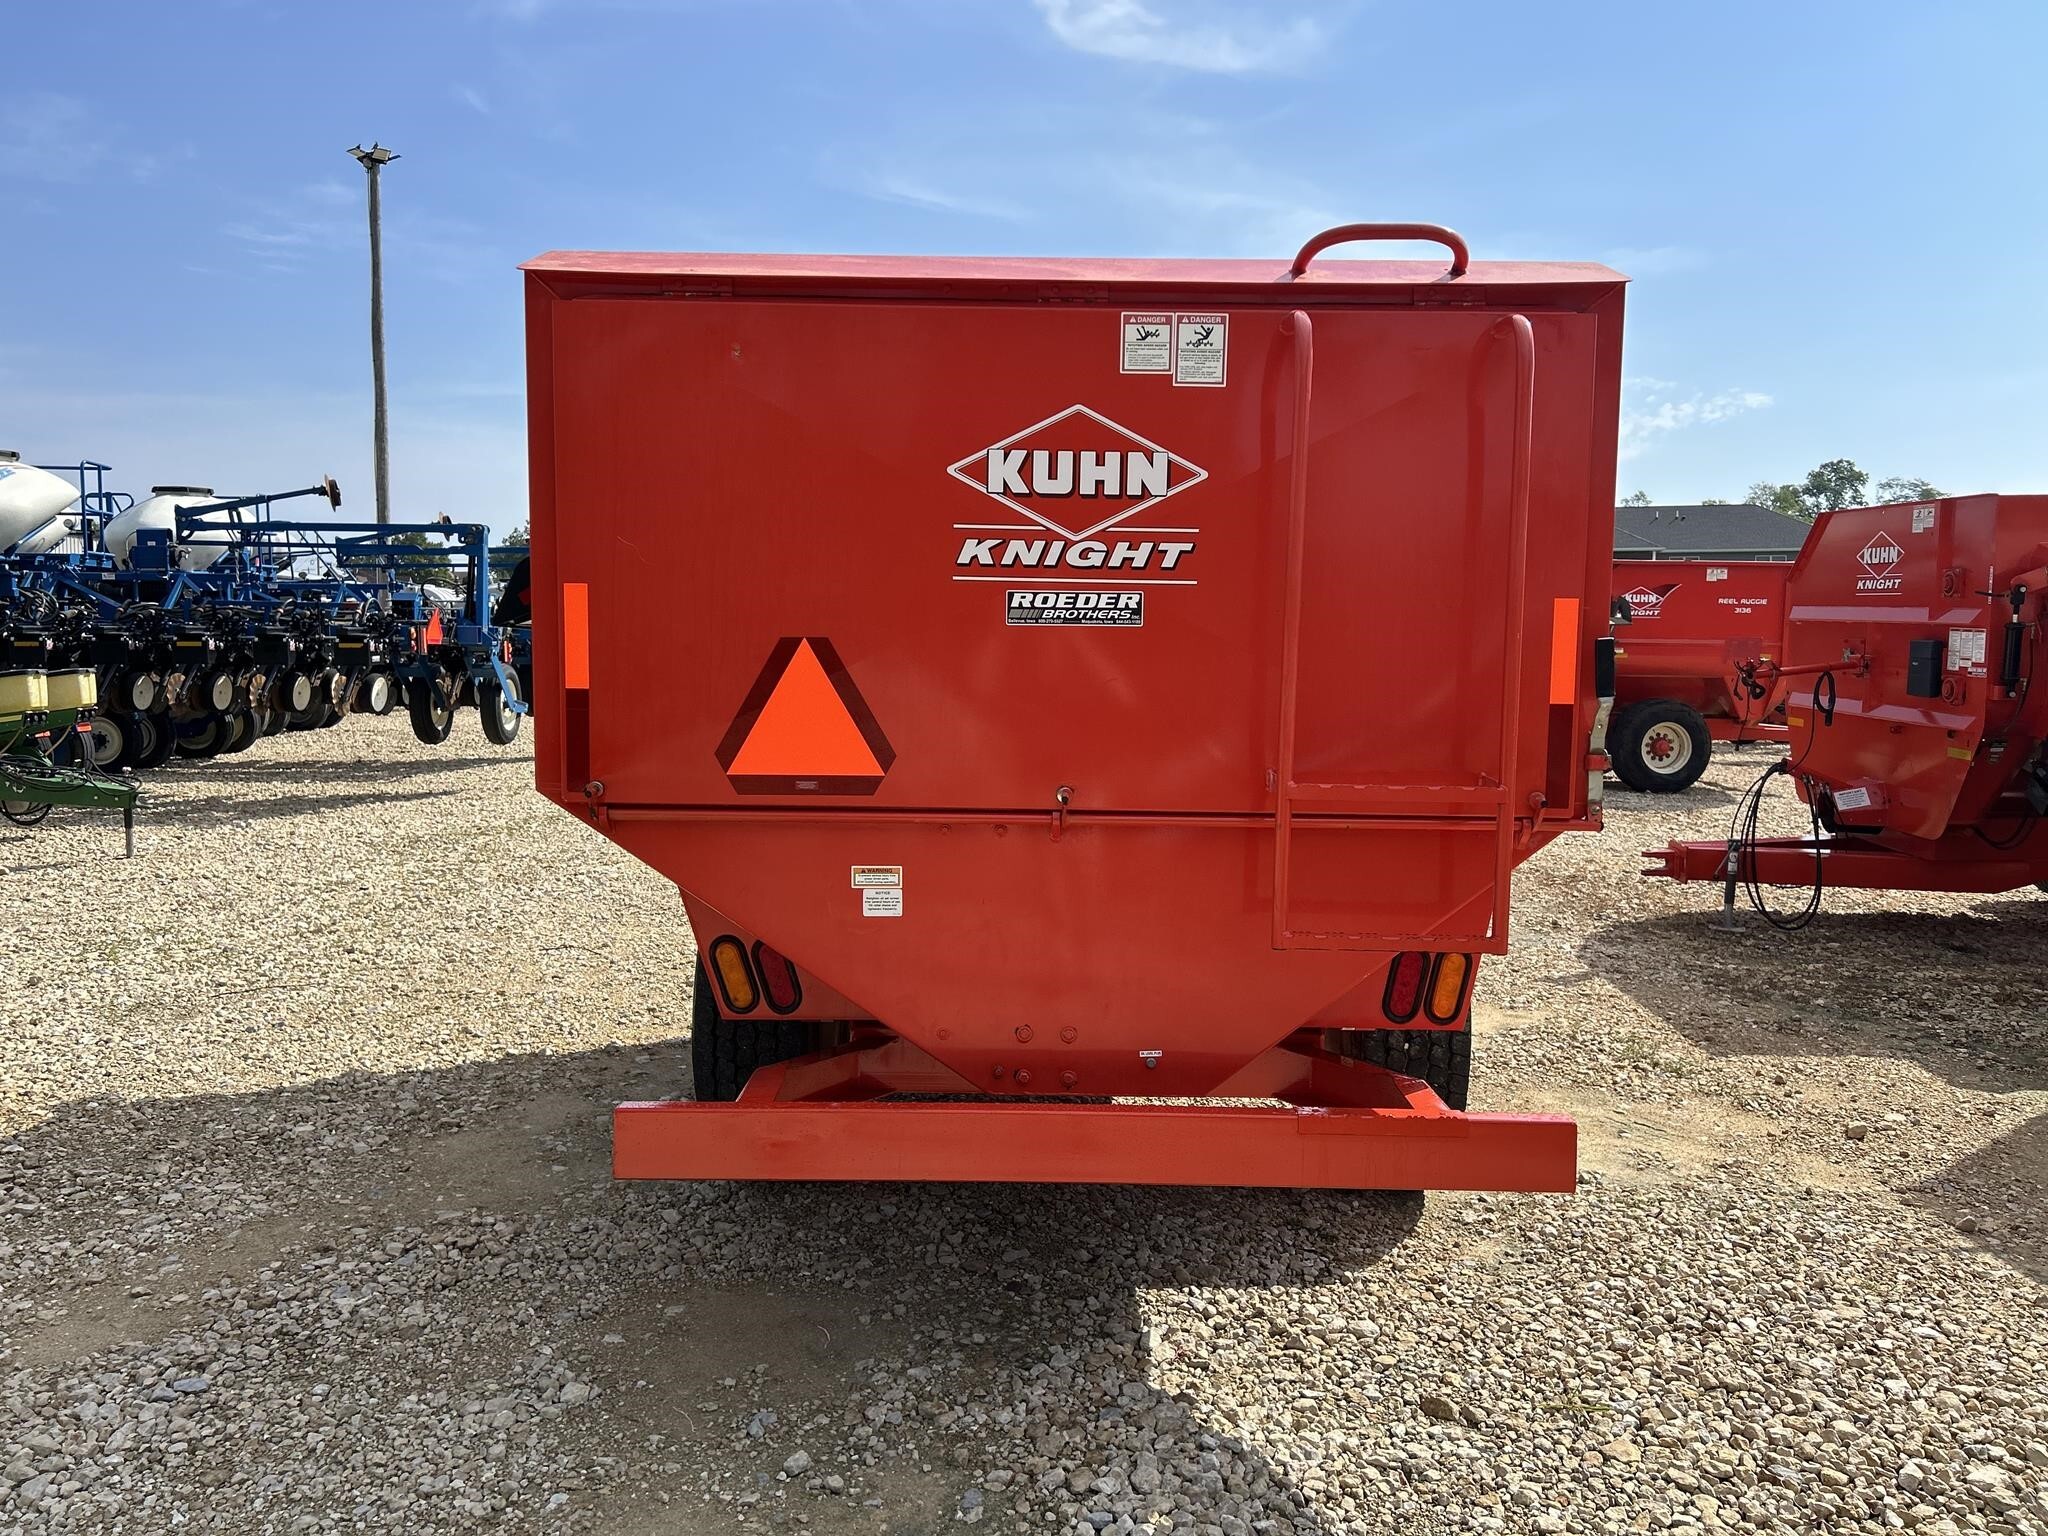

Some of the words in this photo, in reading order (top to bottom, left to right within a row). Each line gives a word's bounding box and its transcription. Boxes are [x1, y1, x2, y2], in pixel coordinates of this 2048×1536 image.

[986, 449, 1171, 499] KUHN
[956, 538, 1196, 571] KNIGHT
[1863, 546, 1898, 565] KUHN
[1856, 578, 1901, 590] KNIGHT
[1010, 592, 1140, 609] ROEDER
[1625, 594, 1657, 603] KUHN
[1042, 609, 1132, 619] BROTHERS
